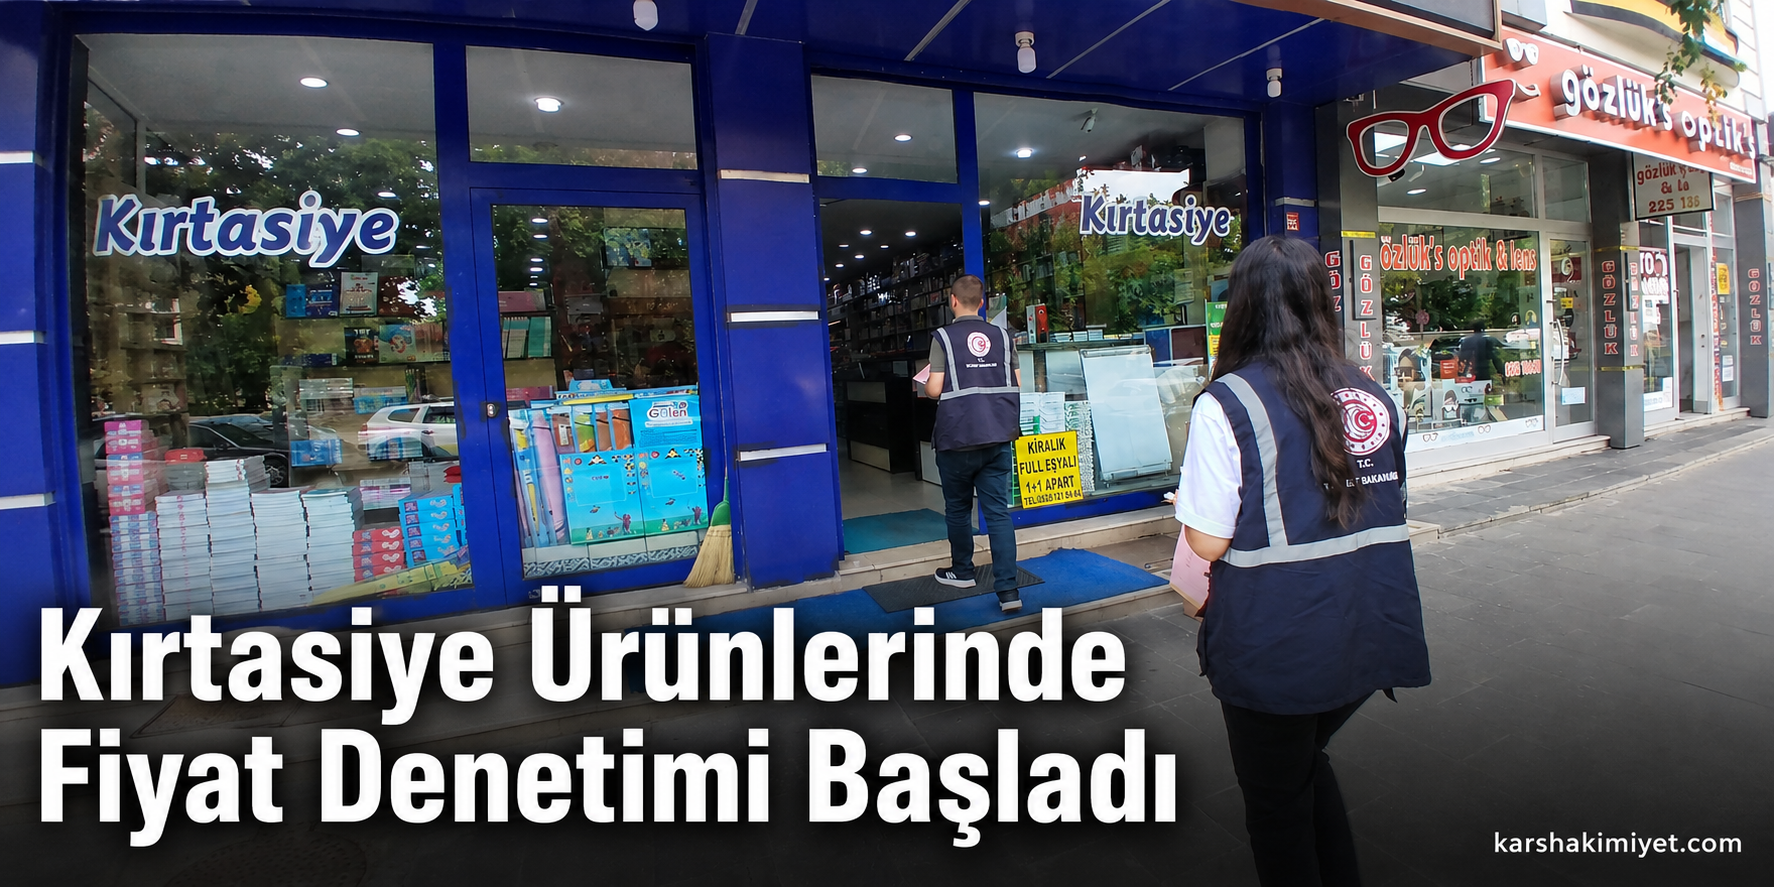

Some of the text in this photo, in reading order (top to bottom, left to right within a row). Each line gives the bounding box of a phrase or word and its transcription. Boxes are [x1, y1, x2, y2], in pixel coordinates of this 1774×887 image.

[1637, 162, 1677, 185] gözlük
[1648, 198, 1675, 213] 225
[93, 190, 400, 268] Kırtasiye
[1079, 194, 1231, 246] Kırtasiye
[1448, 236, 1492, 281] optik
[1496, 239, 1509, 271] &
[1511, 239, 1538, 271] lens
[1359, 254, 1376, 382] GÖZLÜK
[1027, 437, 1066, 455] KİRALIK
[1019, 455, 1077, 476] FULL EŞYALI
[1356, 458, 1374, 469] T.C.
[1026, 475, 1074, 494] 1+1 APART
